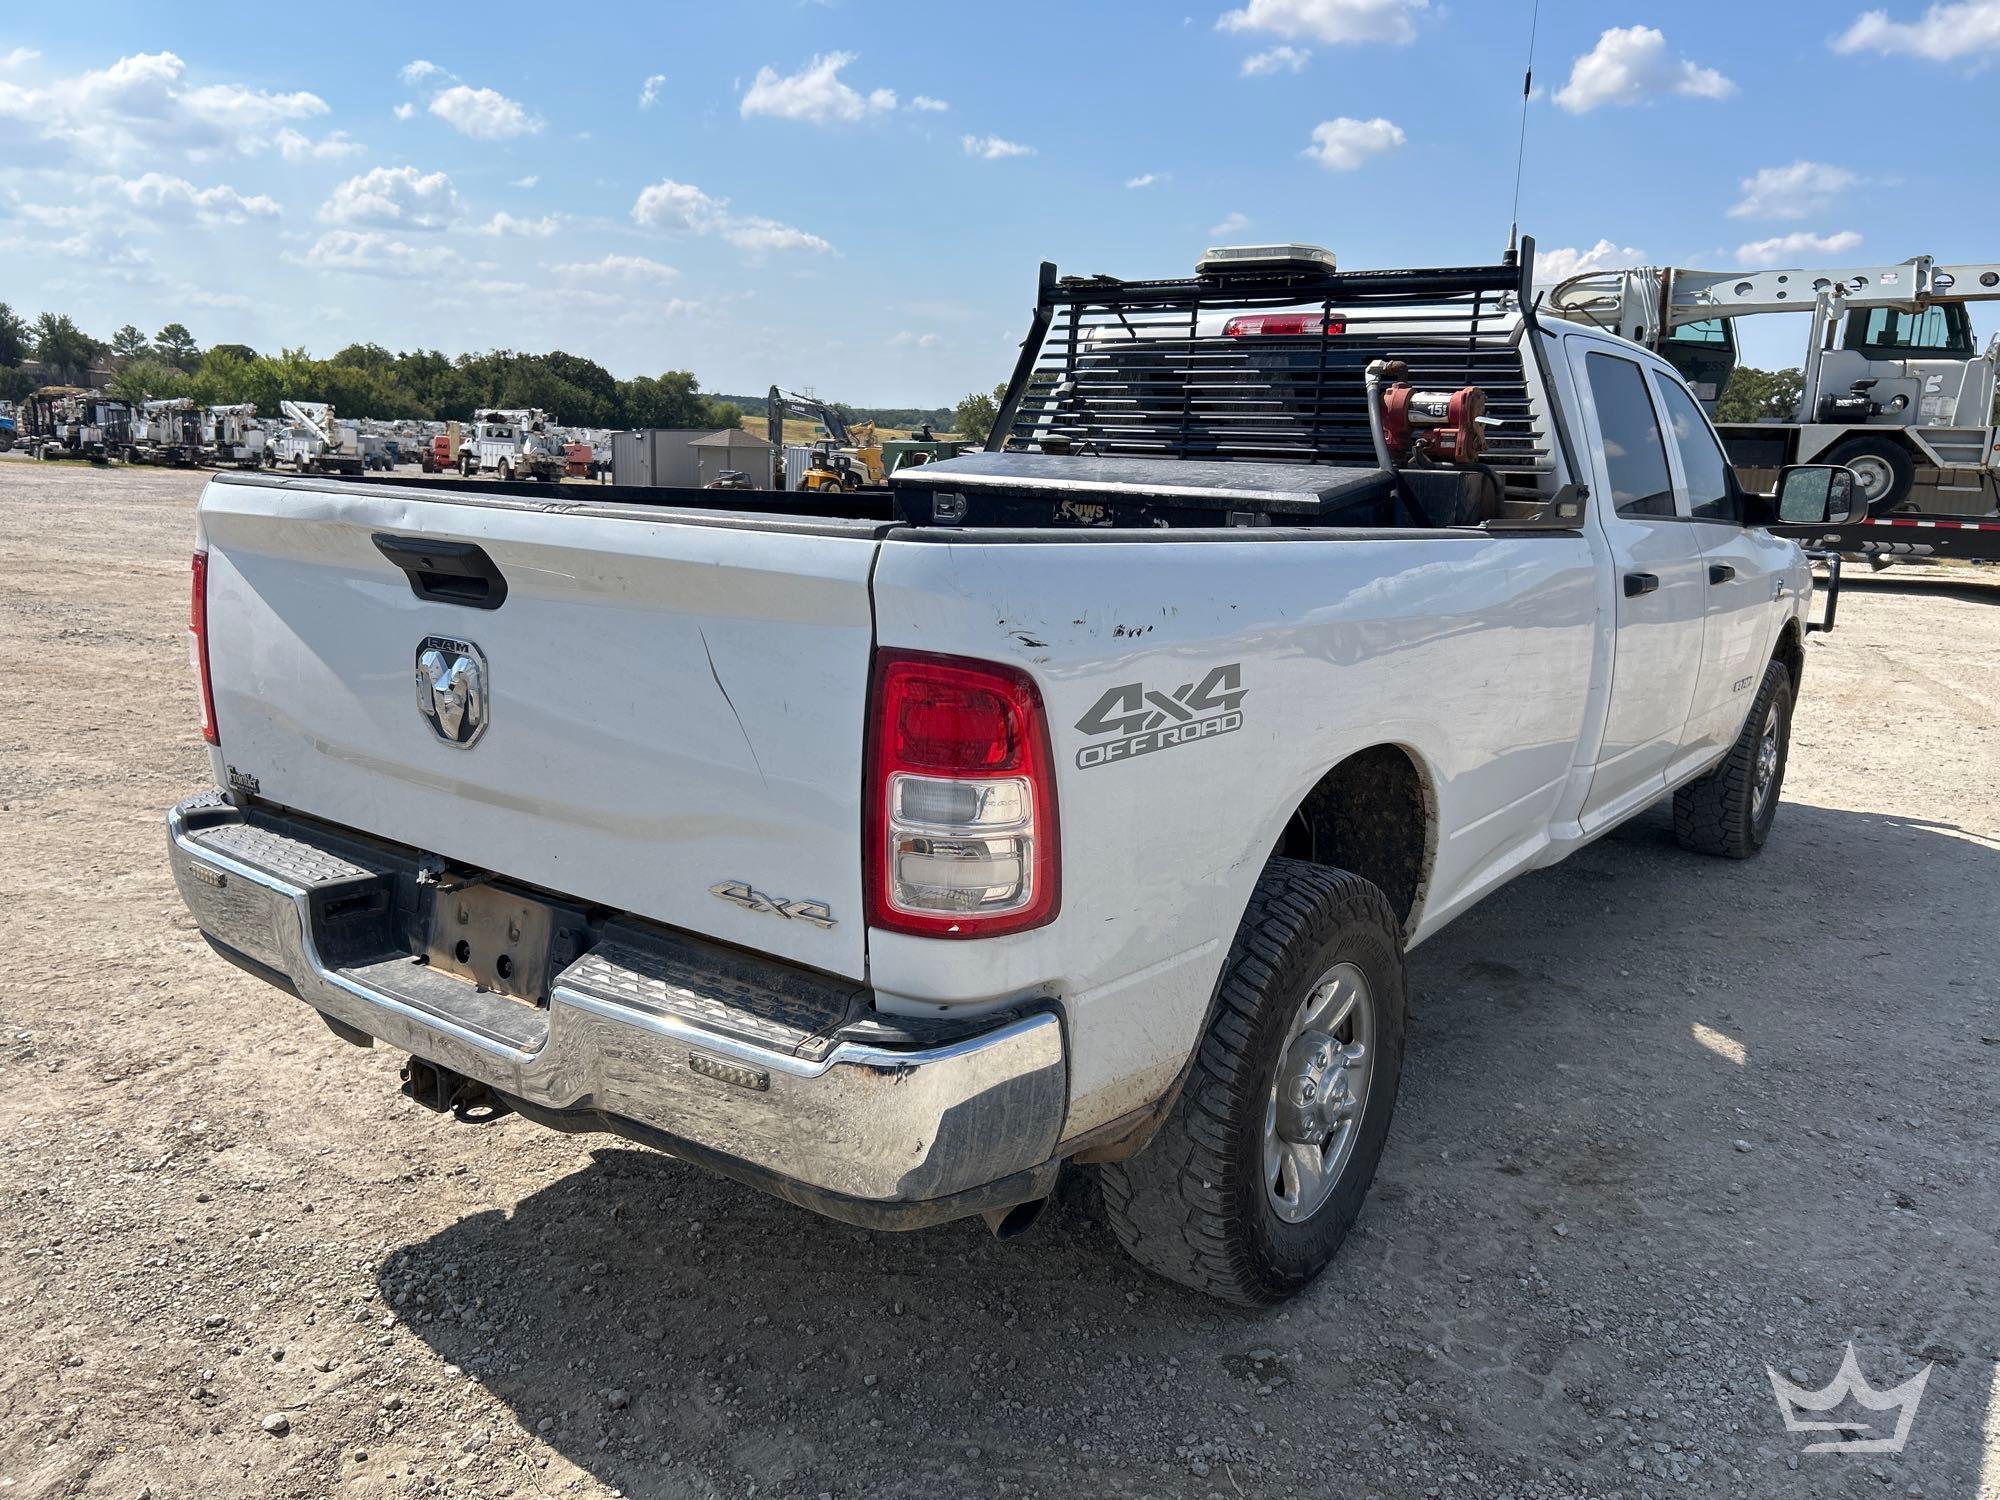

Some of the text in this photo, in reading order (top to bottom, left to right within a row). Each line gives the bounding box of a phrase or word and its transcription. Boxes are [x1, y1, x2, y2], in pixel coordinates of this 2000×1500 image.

[1427, 404, 1442, 416] 15
[1074, 503, 1104, 518] UWS
[427, 637, 470, 653] RAM
[1079, 713, 1241, 767] OFF ROAD
